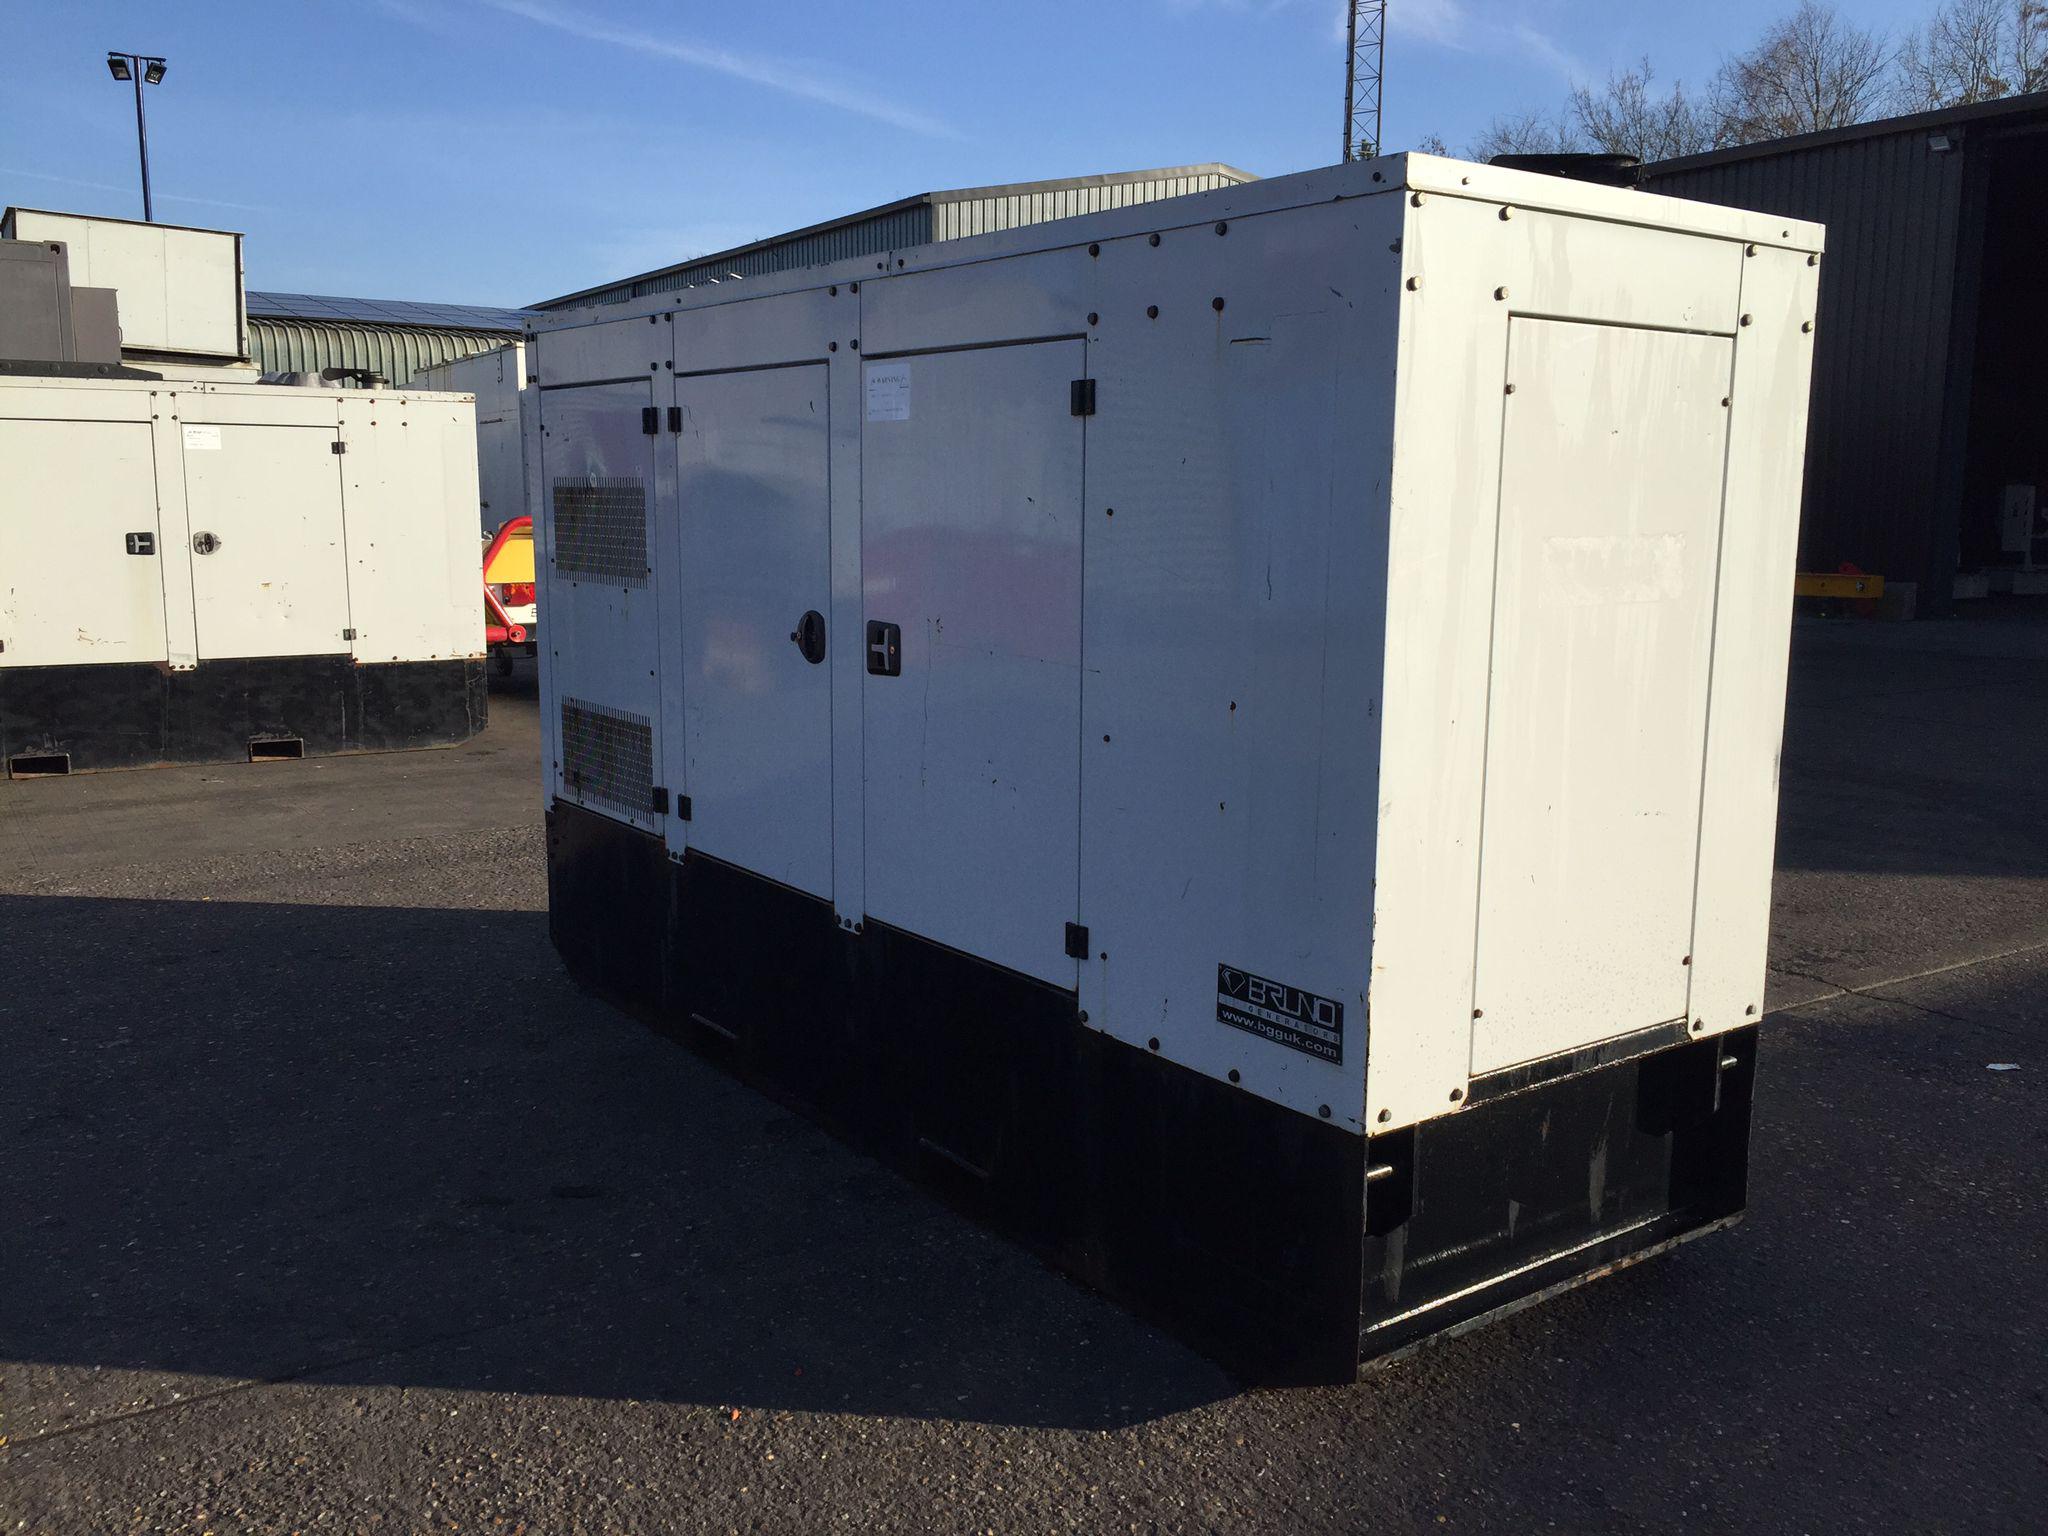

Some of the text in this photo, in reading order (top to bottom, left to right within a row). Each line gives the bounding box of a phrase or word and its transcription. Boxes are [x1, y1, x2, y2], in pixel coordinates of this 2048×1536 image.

[1248, 1005, 1339, 1042] GENERATORS
[1249, 978, 1336, 1028] BRUNO
[1222, 1010, 1337, 1057] www.bgguk.com
